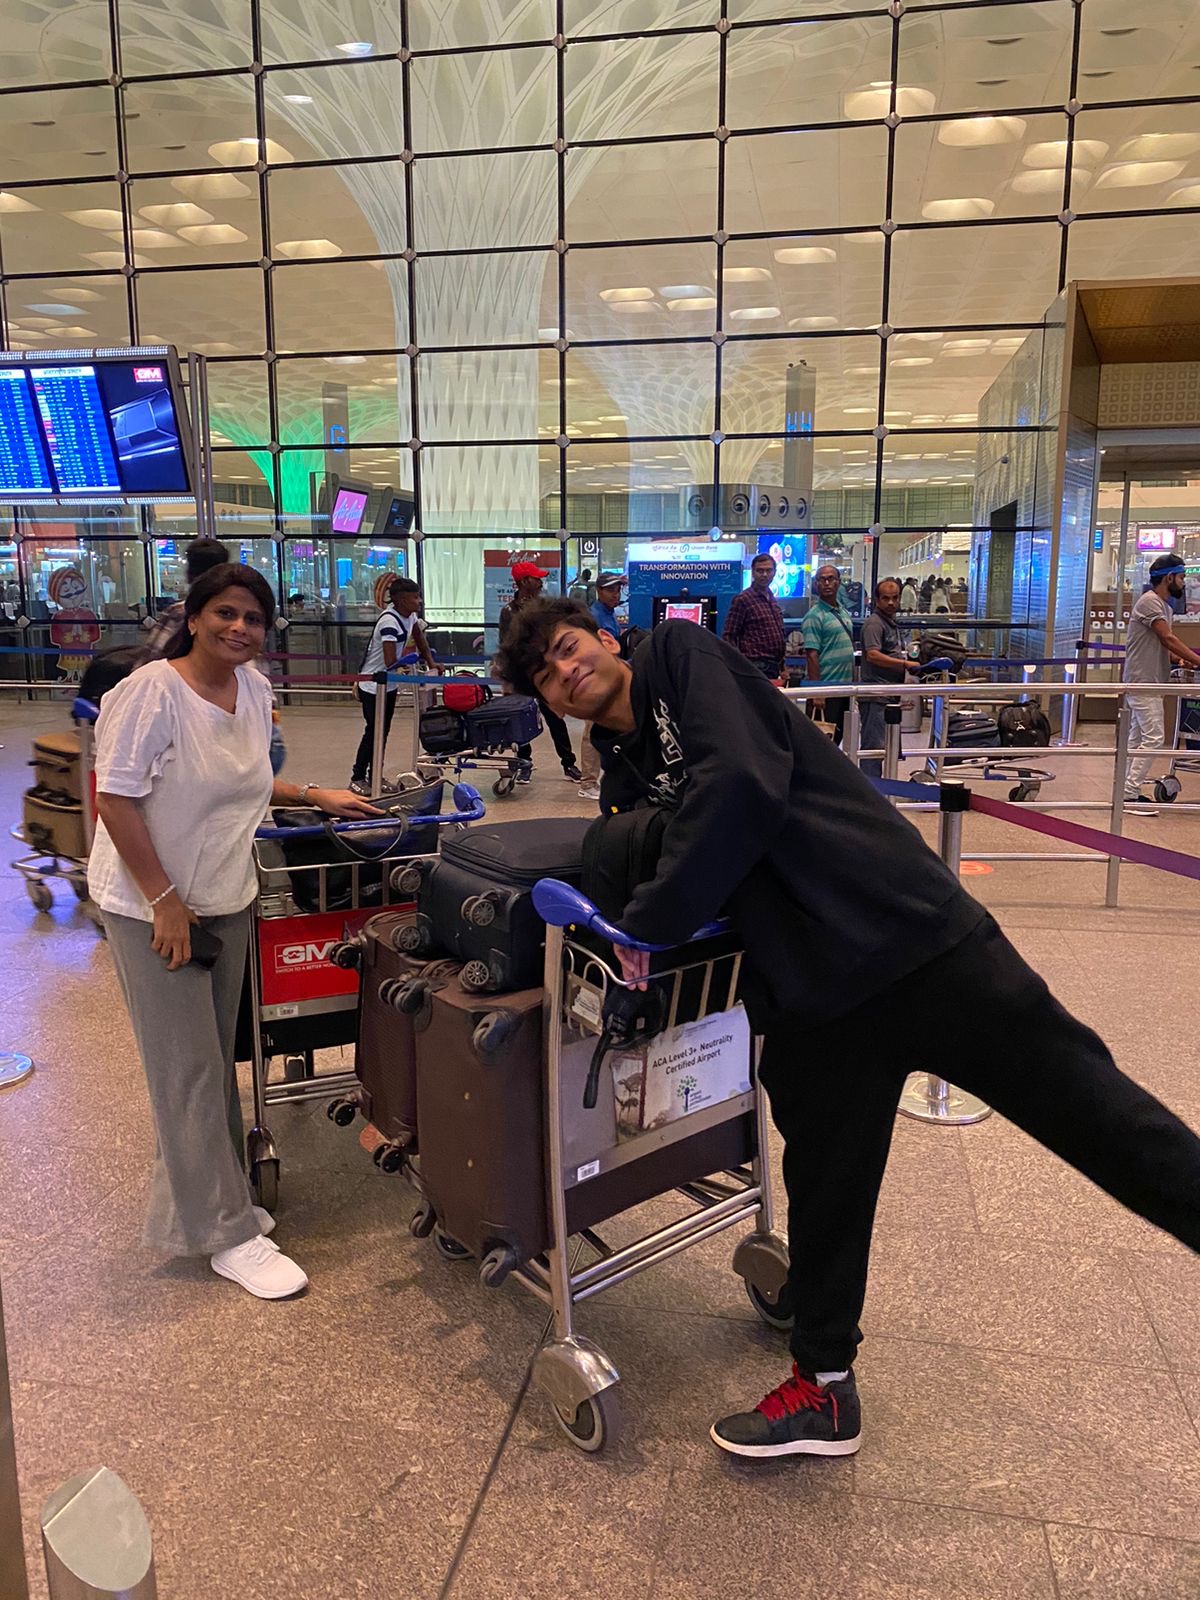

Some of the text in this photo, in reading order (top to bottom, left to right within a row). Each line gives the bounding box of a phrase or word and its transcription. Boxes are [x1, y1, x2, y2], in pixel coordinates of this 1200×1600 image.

[639, 563, 731, 571] TRANSFORMATION WITH
[660, 572, 709, 580] INNOVATION
[652, 1057, 668, 1069] ACA
[668, 1050, 688, 1064] Level
[700, 1033, 733, 1052] Neutrality
[665, 1048, 721, 1076] Certified Airport
